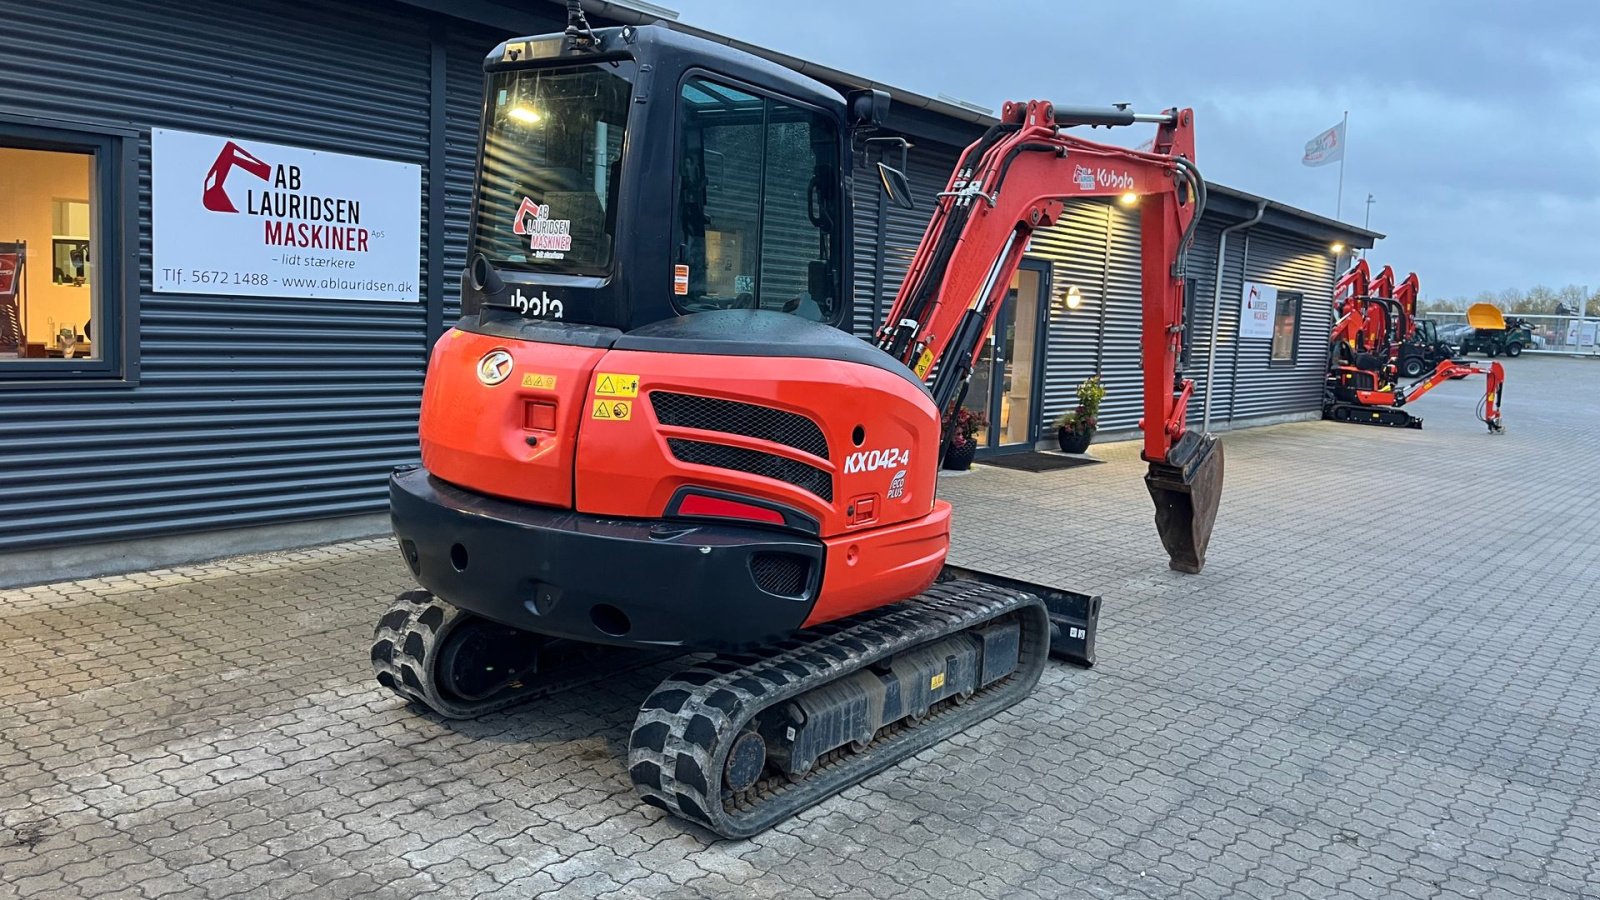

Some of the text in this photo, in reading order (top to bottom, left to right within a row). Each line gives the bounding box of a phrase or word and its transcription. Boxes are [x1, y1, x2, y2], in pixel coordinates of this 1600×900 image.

[275, 164, 301, 190] AB
[1097, 167, 1134, 189] Kubota
[247, 189, 360, 224] LAURIDSEN
[538, 205, 549, 219] AB
[265, 220, 385, 252] MASKINER ApS
[527, 220, 569, 235] LAURIDSEN
[531, 235, 571, 250] MASKINER
[282, 254, 301, 266] lidt
[304, 256, 355, 269] stærkere
[162, 268, 187, 285] Tlf.
[191, 269, 229, 284] 5672
[233, 272, 269, 286] 1488
[282, 275, 412, 293] www.ablauridsen.dk
[843, 448, 910, 474] KX042-4
[887, 488, 903, 499] PLUS
